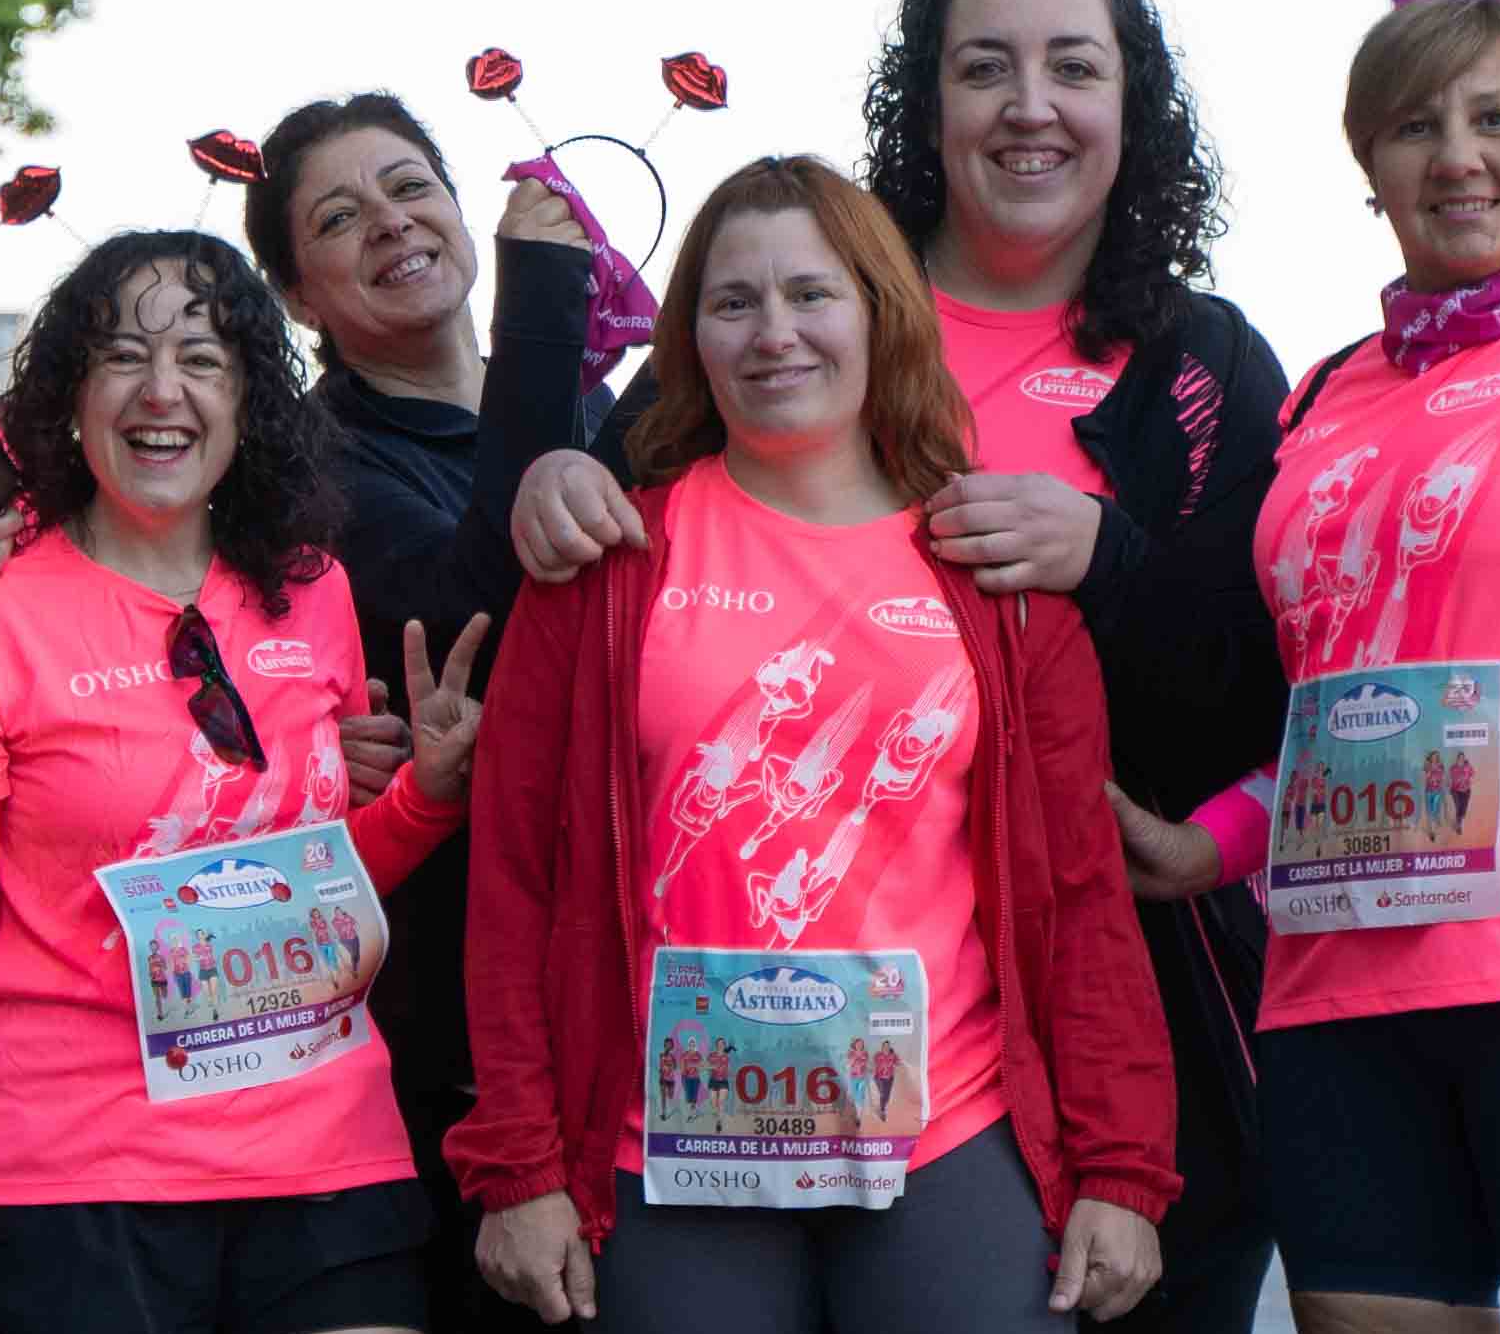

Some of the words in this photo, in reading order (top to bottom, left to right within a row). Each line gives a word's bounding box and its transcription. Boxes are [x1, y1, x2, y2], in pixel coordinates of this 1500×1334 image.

[1030, 376, 1107, 401] ASTURIAN
[662, 582, 776, 615] OYSHO
[877, 606, 960, 630] ASTURIAN
[1329, 780, 1416, 827] 016
[1342, 834, 1392, 856] 30881
[1333, 863, 1348, 877] DE
[1350, 861, 1365, 875] LA
[1366, 858, 1404, 875] MUJER
[1415, 855, 1467, 872] MADRID
[1288, 891, 1351, 917] OYSHO
[1393, 889, 1473, 907] Santander
[222, 937, 315, 988] 016
[665, 974, 706, 989] SUMA
[246, 988, 303, 1015] 12926
[732, 987, 838, 1012] ASTURIANA
[176, 1026, 236, 1049] CARRERA
[238, 1021, 255, 1037] DE
[257, 1018, 275, 1034] LA
[277, 1011, 317, 1030] MUJER
[178, 1051, 262, 1083] OYSHO
[735, 1065, 842, 1106] 016
[753, 1117, 817, 1136] 30489
[676, 1139, 737, 1154] CARRERA
[740, 1139, 758, 1154] DE
[762, 1140, 778, 1155] LA
[783, 1140, 831, 1156] MUJER
[842, 1140, 894, 1156] MADRID
[673, 1168, 761, 1190] OYSHO
[818, 1172, 898, 1190] Santander
